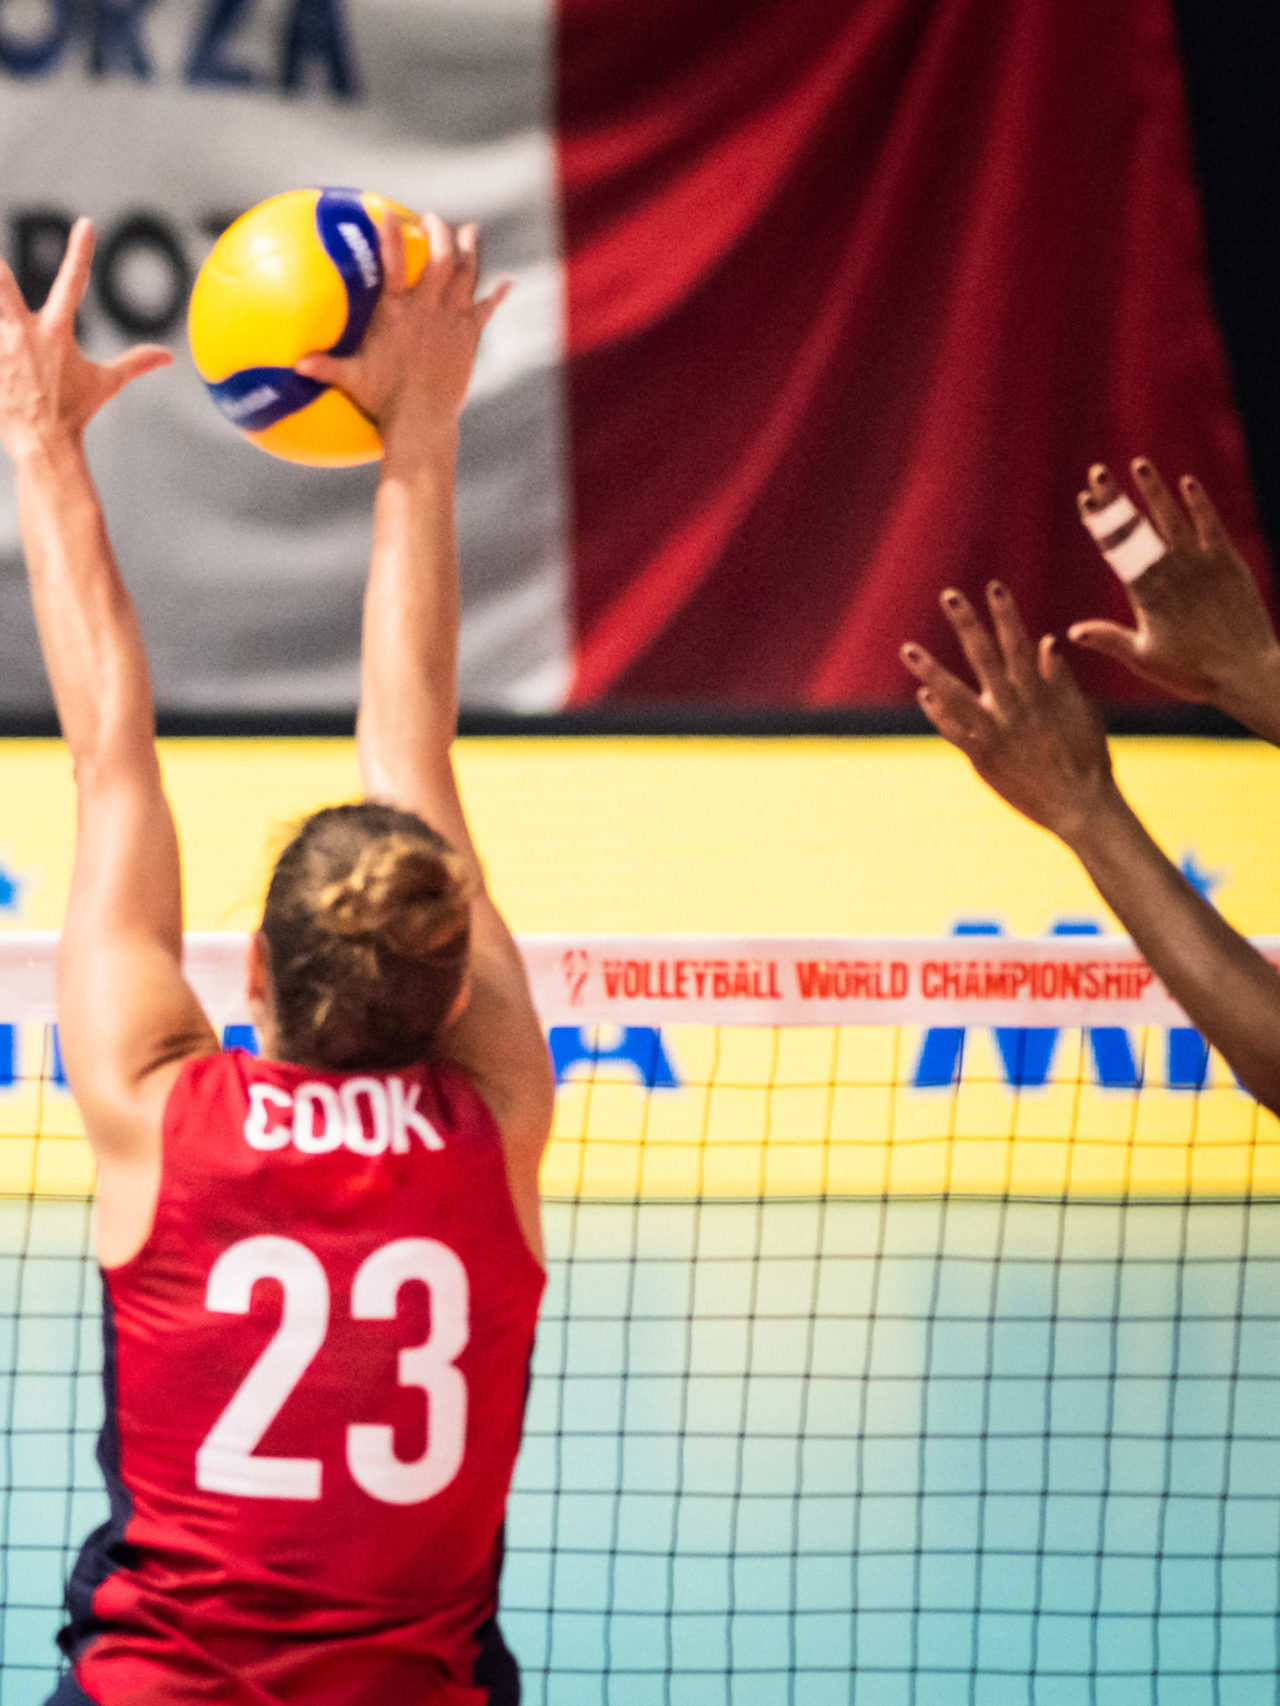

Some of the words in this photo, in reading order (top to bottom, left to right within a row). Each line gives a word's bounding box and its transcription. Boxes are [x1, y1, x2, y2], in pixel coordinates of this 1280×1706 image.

[603, 960, 781, 999] VOLLEYBALL
[795, 960, 907, 999] WORLD
[922, 961, 1154, 999] CHAMPIONSHIP
[243, 1076, 445, 1155] COOK
[195, 1235, 470, 1505] 23
